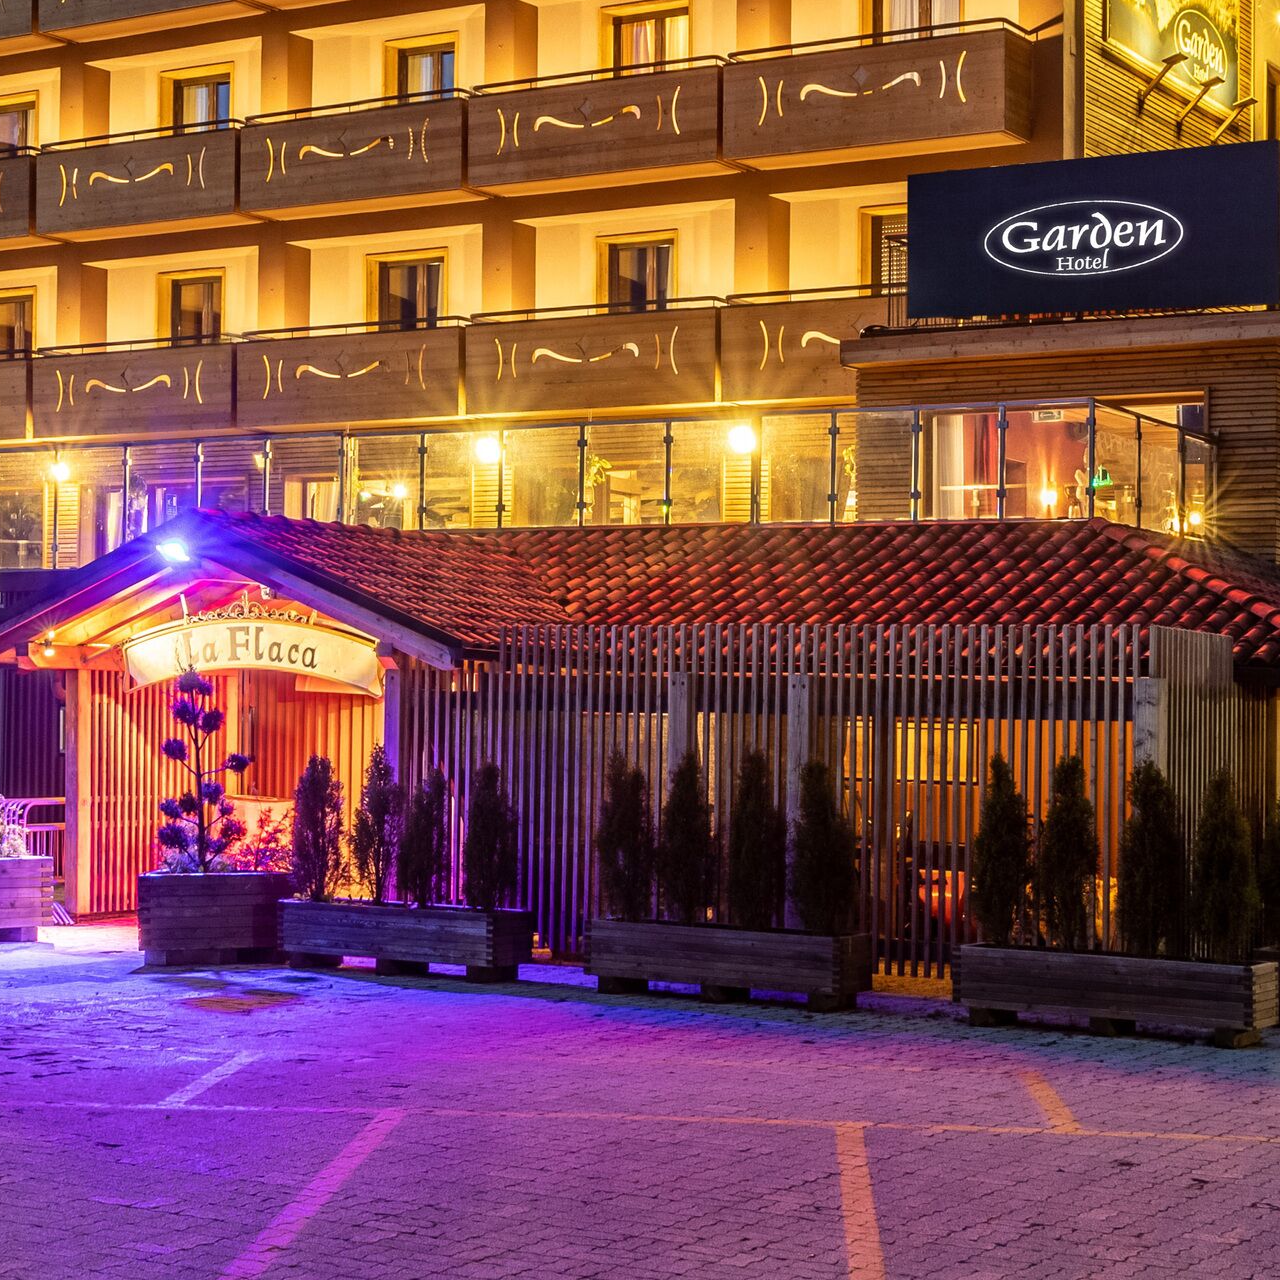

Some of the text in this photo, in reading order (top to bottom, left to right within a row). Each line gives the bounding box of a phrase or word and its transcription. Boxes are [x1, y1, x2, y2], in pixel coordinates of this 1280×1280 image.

[1178, 19, 1223, 74] Garden
[1001, 211, 1167, 254] Garden
[1055, 248, 1110, 271] Hotel
[182, 626, 318, 670] La Flaca
